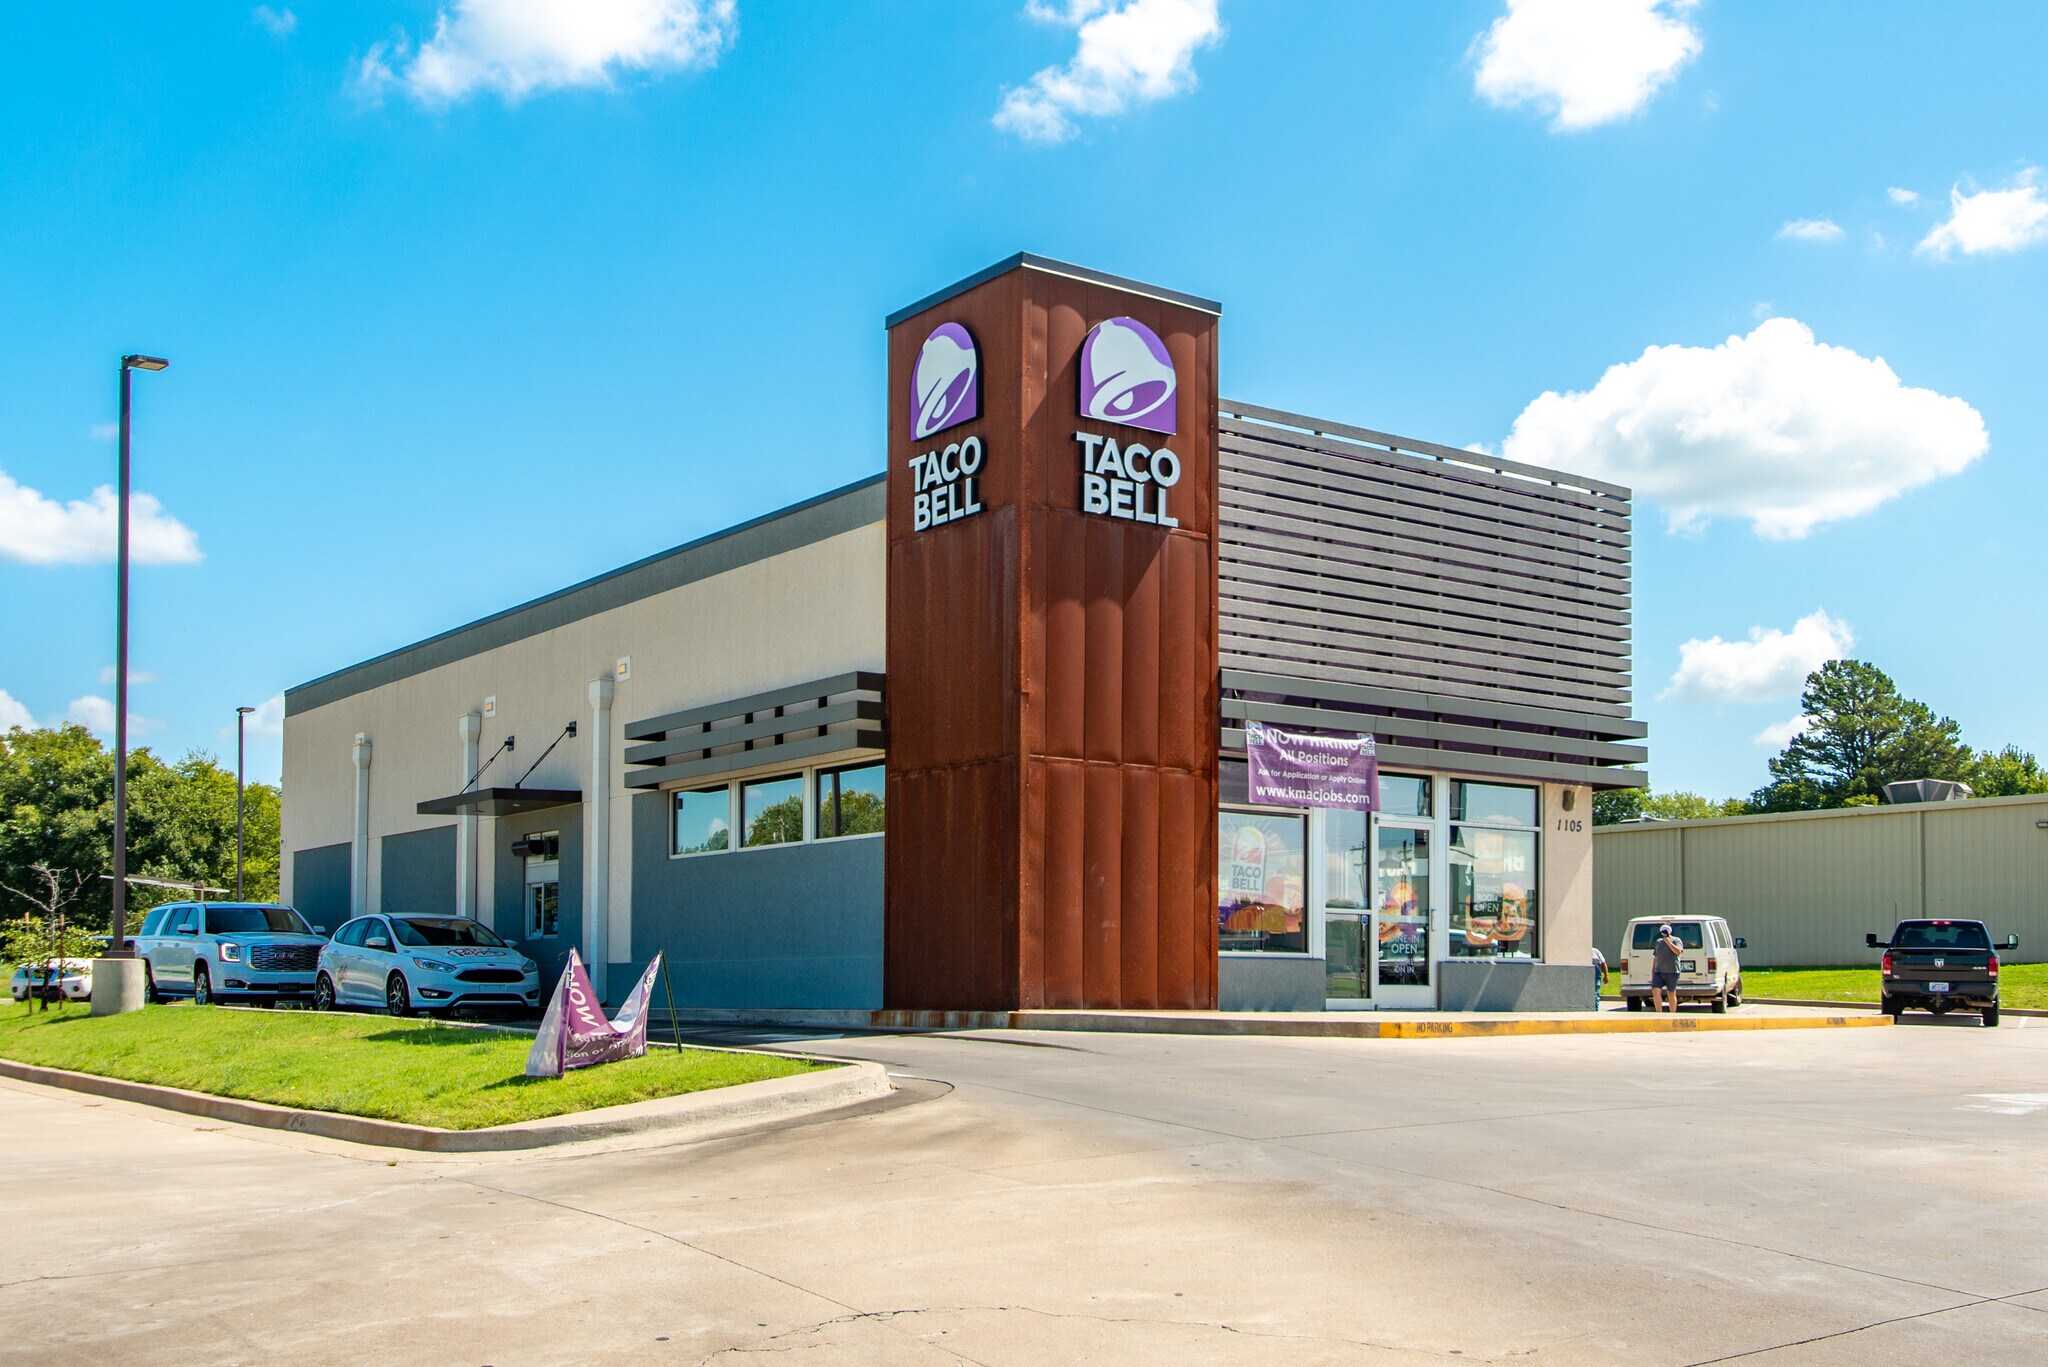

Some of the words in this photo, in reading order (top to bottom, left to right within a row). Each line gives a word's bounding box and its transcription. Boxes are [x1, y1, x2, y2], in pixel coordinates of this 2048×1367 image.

[908, 435, 982, 493] TACO
[1076, 430, 1181, 488] TACO
[913, 477, 981, 533] BELL
[1083, 472, 1179, 528] BELL
[1279, 749, 1295, 762] All
[1298, 751, 1349, 767] Positions
[1257, 768, 1270, 776] Ask
[1270, 769, 1281, 777] for
[1282, 770, 1320, 780] Application
[1328, 774, 1347, 784] Apply
[1347, 776, 1367, 785] Online
[1255, 785, 1370, 804] www.kmacjobs.com
[1557, 819, 1582, 832] 1105
[1231, 864, 1262, 879] TACO
[1232, 877, 1260, 891] BELL
[1475, 902, 1500, 913] OPEN
[1391, 943, 1418, 954] OPEN
[1427, 1022, 1453, 1033] PARKING
